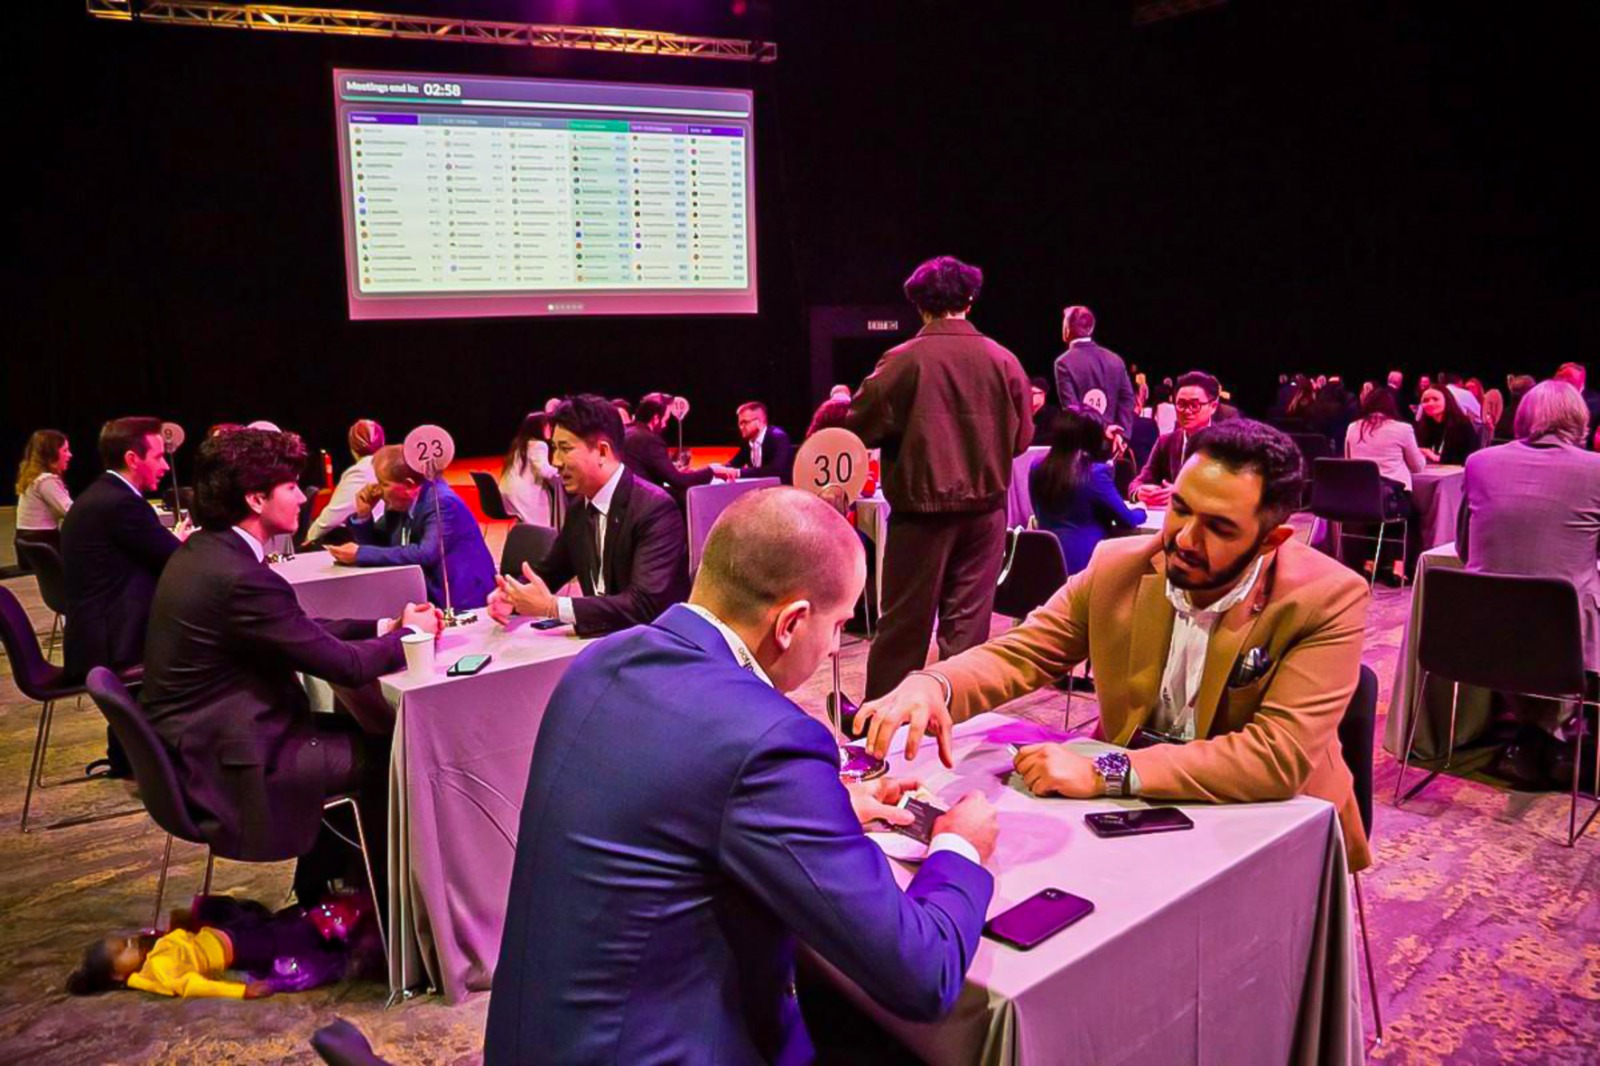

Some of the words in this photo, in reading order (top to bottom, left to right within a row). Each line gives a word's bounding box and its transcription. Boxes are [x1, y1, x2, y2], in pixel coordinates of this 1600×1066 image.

[423, 83, 461, 96] 02:58
[417, 439, 444, 461] 23
[814, 452, 852, 487] 30
